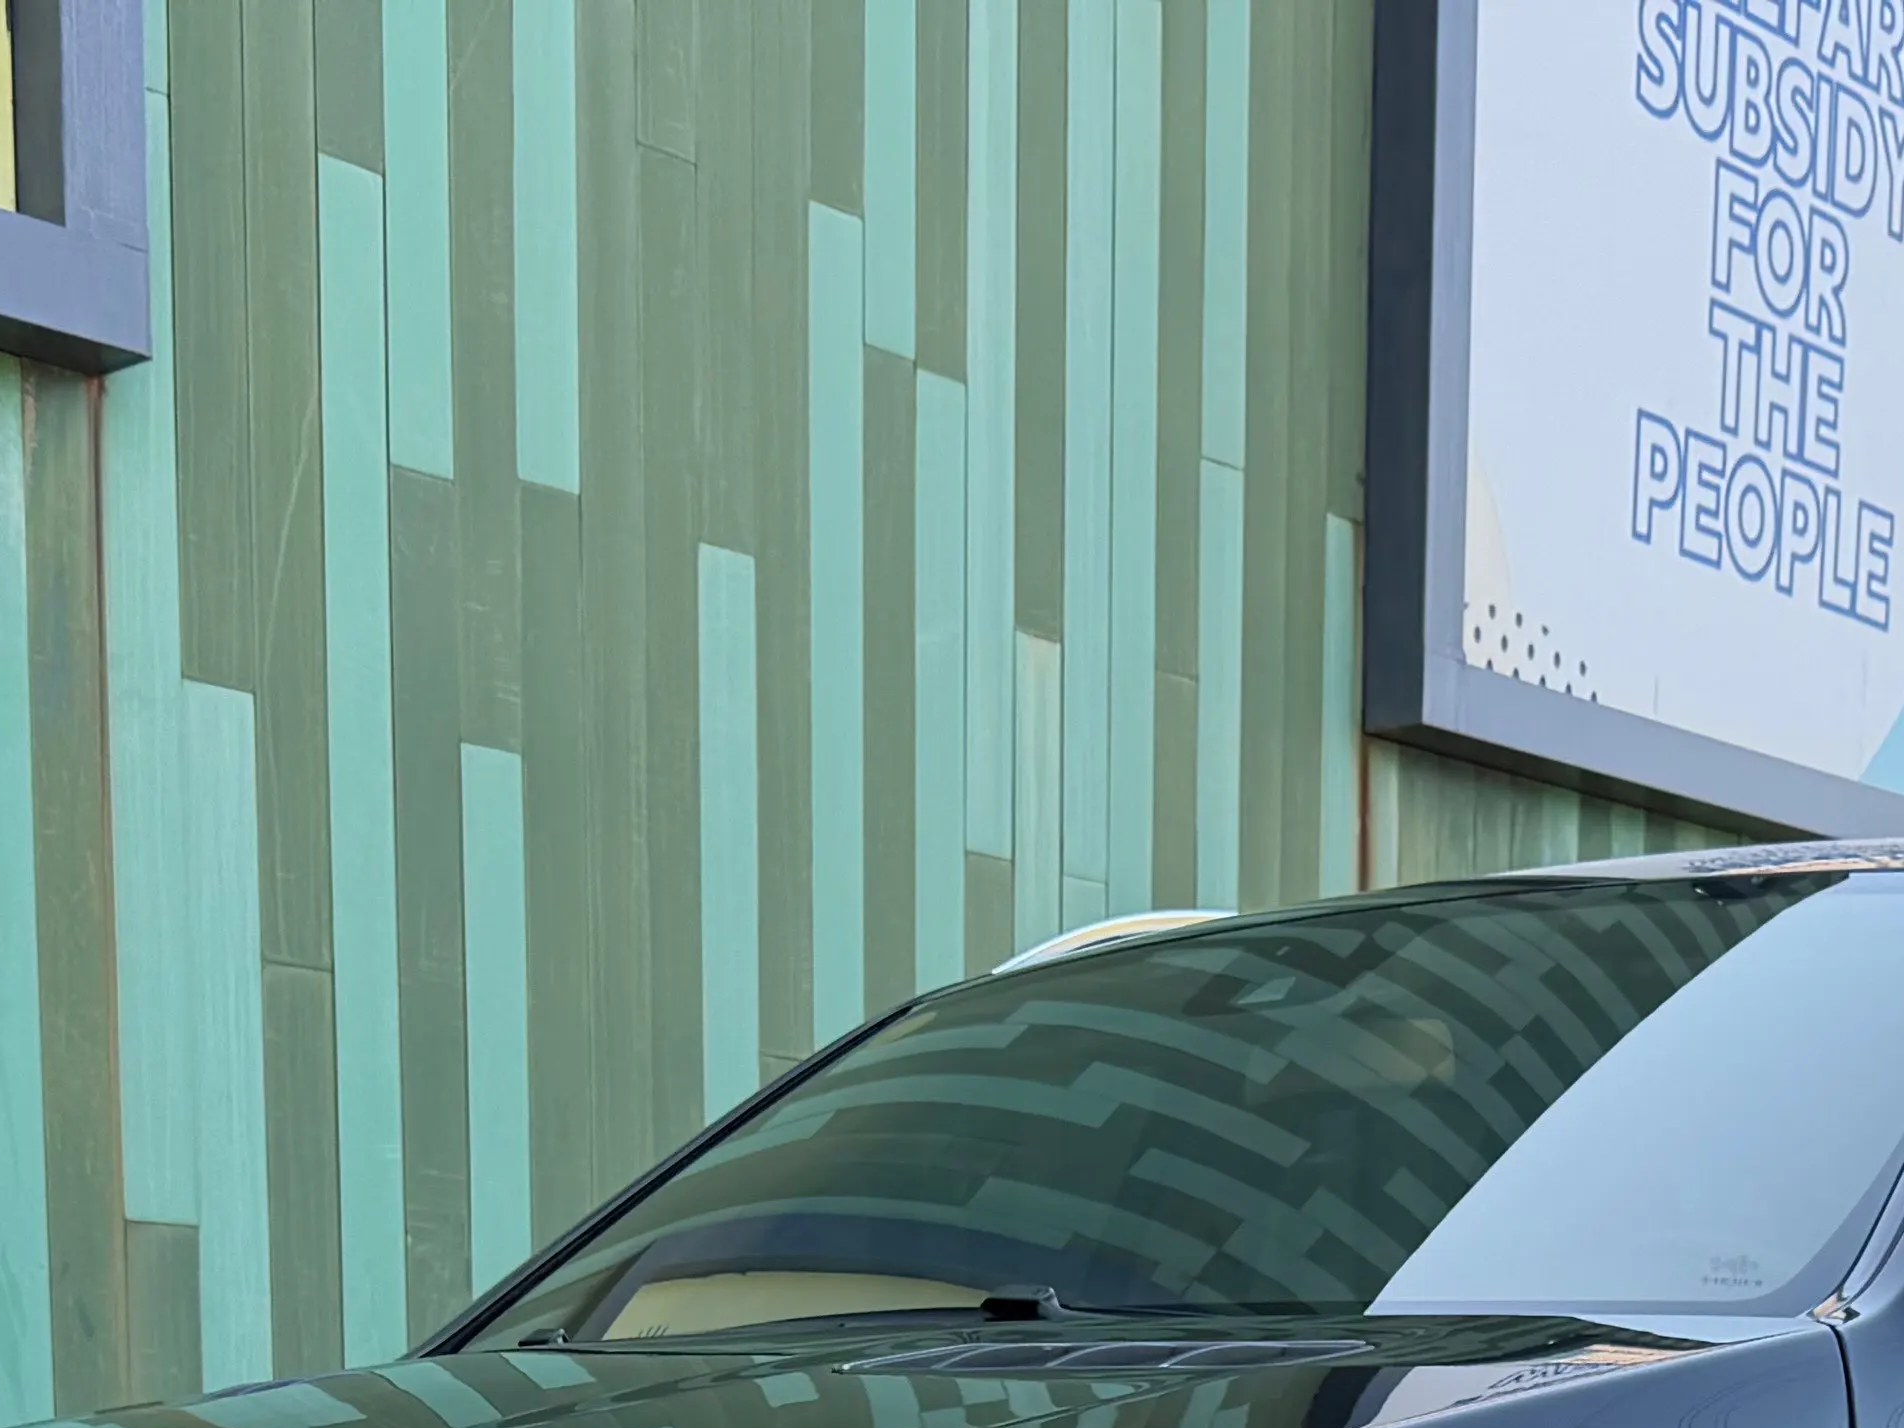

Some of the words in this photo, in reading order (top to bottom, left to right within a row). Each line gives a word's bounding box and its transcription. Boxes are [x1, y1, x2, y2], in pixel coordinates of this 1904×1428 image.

[1711, 158, 1848, 347] FOR
[1708, 298, 1844, 475] THE
[1631, 408, 1894, 633] PEOPLE
